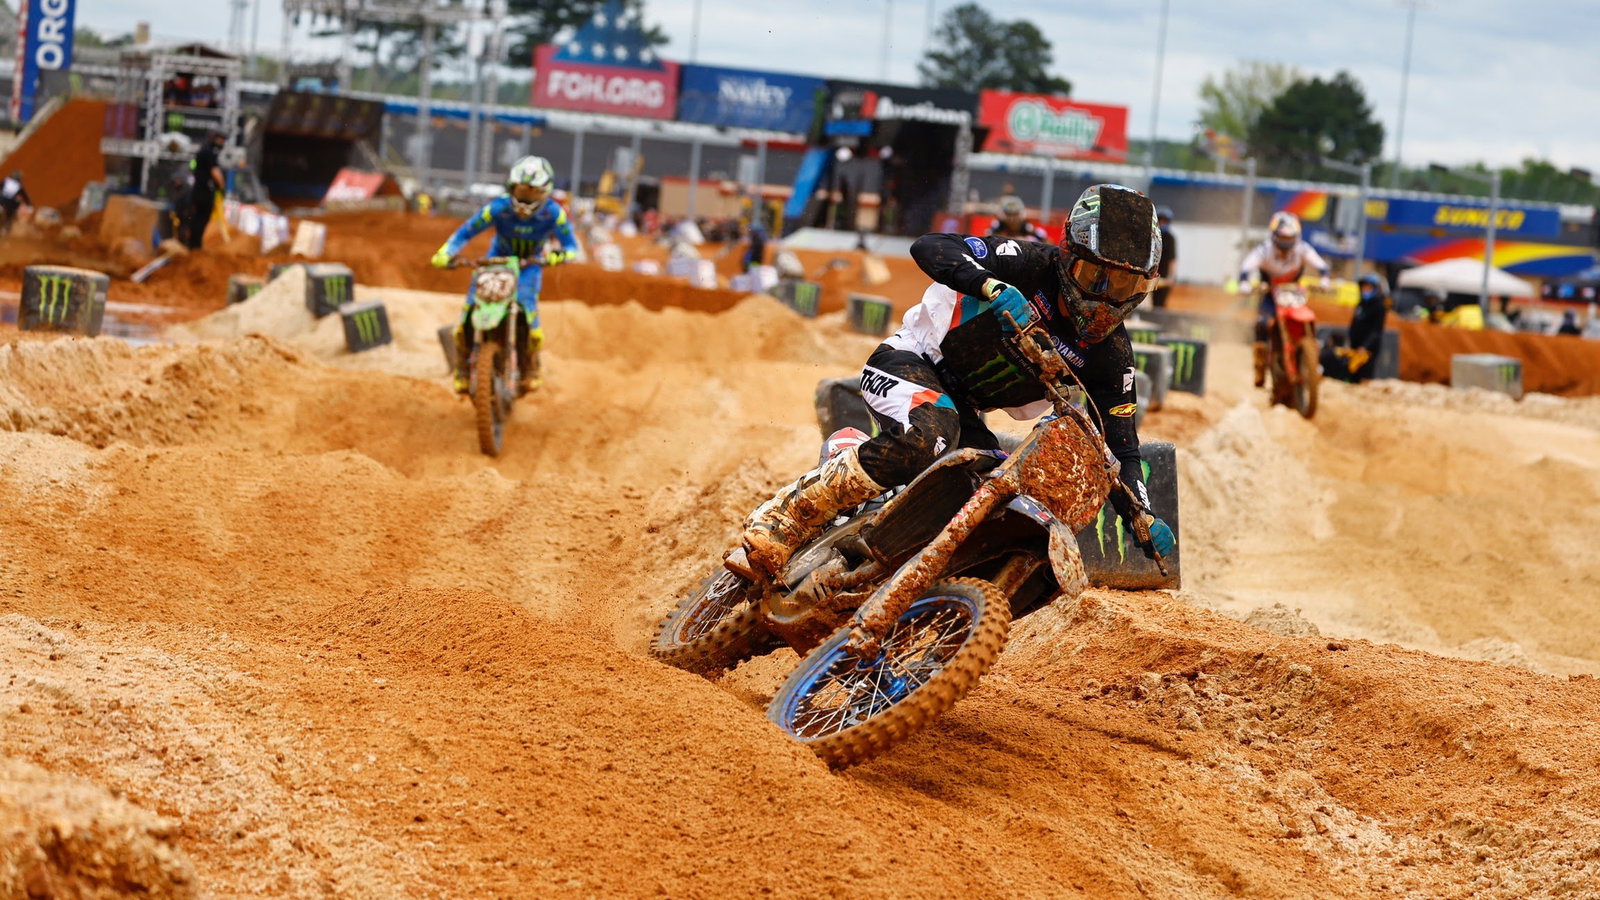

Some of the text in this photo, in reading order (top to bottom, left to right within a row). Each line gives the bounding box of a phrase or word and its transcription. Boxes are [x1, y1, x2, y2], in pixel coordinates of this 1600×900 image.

[1434, 206, 1525, 230] SUNOCO
[1057, 341, 1086, 368] YAMAH
[860, 368, 899, 399] THOR
